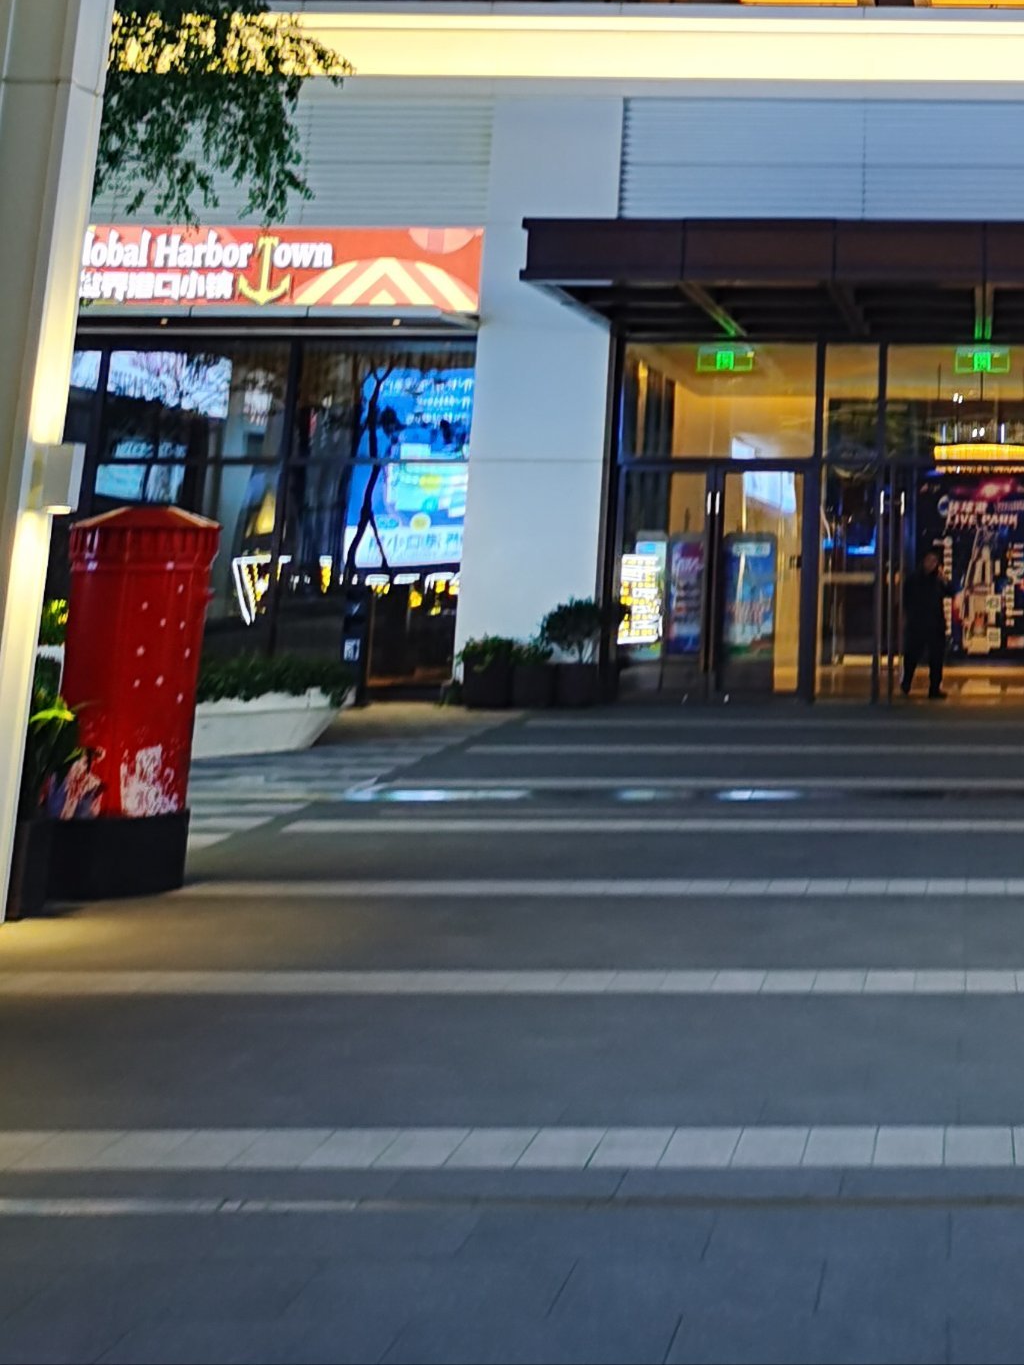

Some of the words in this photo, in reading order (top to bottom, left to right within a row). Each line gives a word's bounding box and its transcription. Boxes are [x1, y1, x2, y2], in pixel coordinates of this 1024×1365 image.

[82, 229, 152, 268] lobal
[154, 229, 253, 269] Harbor
[257, 235, 334, 269] Town
